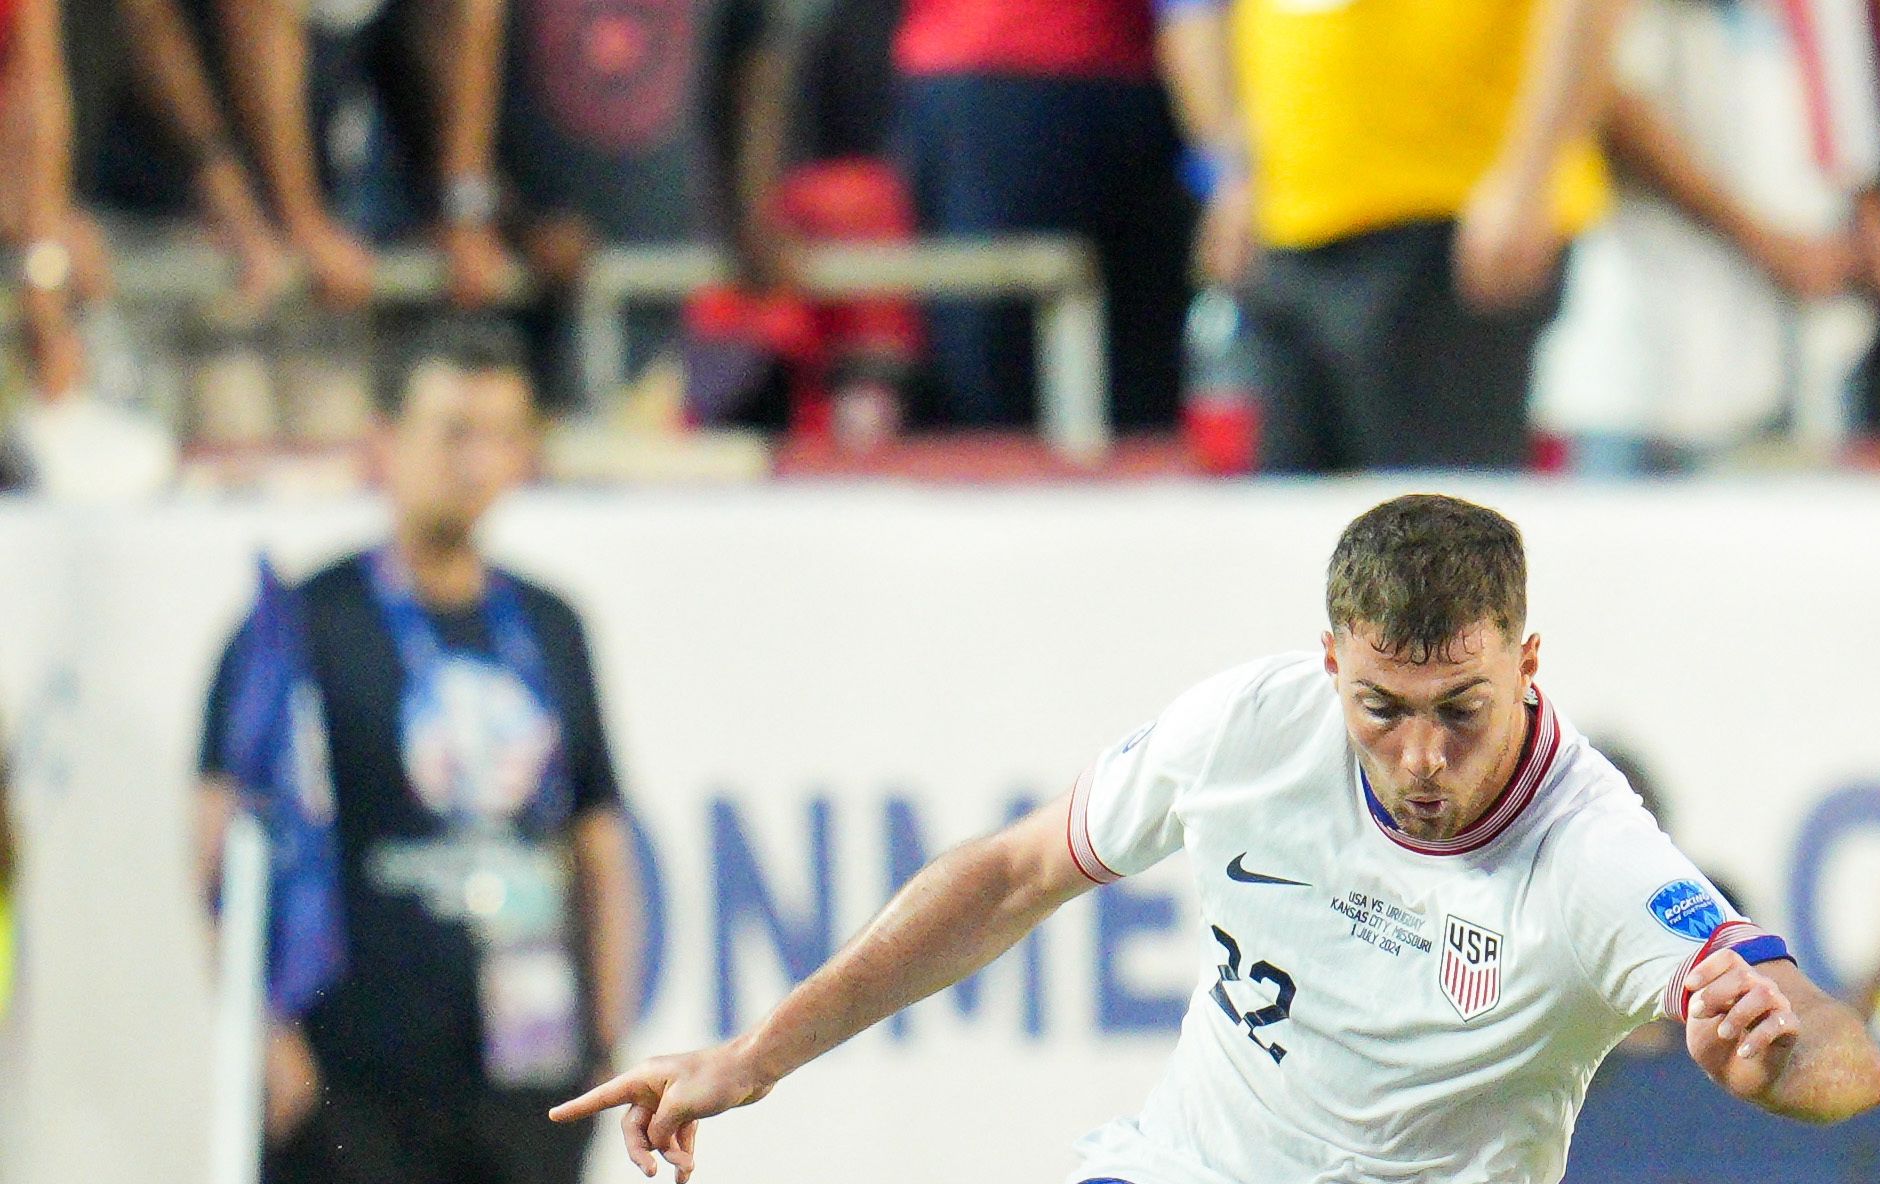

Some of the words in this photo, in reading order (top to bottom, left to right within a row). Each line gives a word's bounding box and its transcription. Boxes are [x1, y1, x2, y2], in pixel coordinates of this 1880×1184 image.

[1330, 896, 1369, 924] KANSAS
[1391, 925, 1433, 953] MISSOURI
[1348, 891, 1367, 908] USA
[1386, 904, 1426, 931] URUGUAY
[1664, 893, 1711, 920] ROCKING
[1356, 927, 1379, 945] JULY
[1379, 937, 1401, 956] 2024
[1450, 922, 1498, 965] USA
[1208, 924, 1297, 1067] 22
